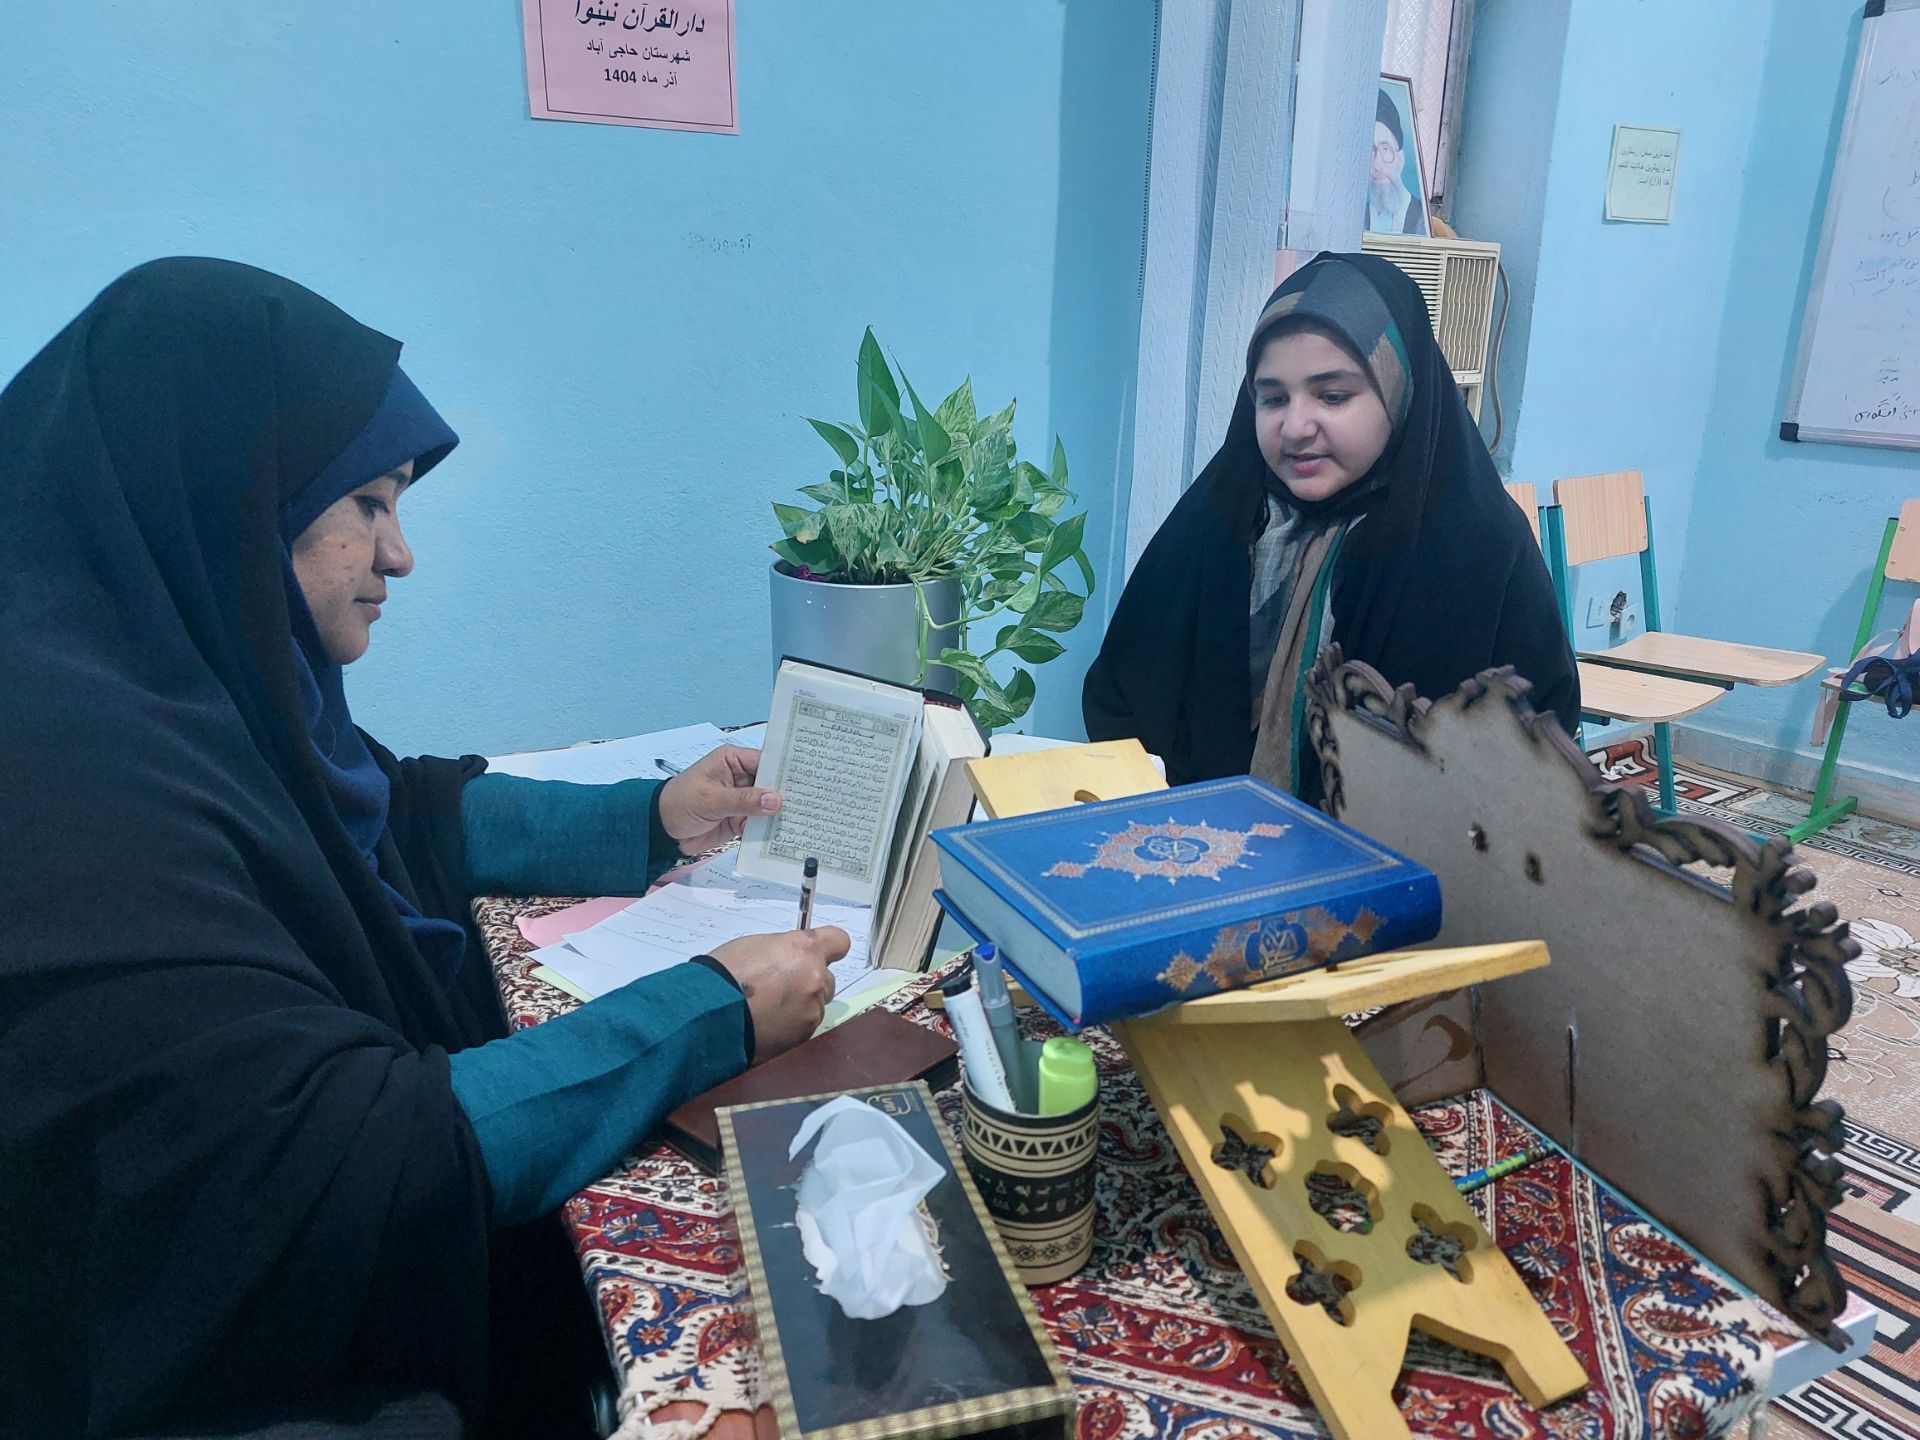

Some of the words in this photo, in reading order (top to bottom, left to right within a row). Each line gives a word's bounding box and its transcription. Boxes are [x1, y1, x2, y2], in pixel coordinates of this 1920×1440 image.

[574, 0, 620, 27] نینوا
[586, 38, 604, 55] آباد
[608, 43, 639, 59] حاجی
[642, 46, 691, 65] شهرستان
[603, 68, 637, 84] 1404
[641, 70, 658, 84] ماه
[662, 71, 678, 89] آذر
